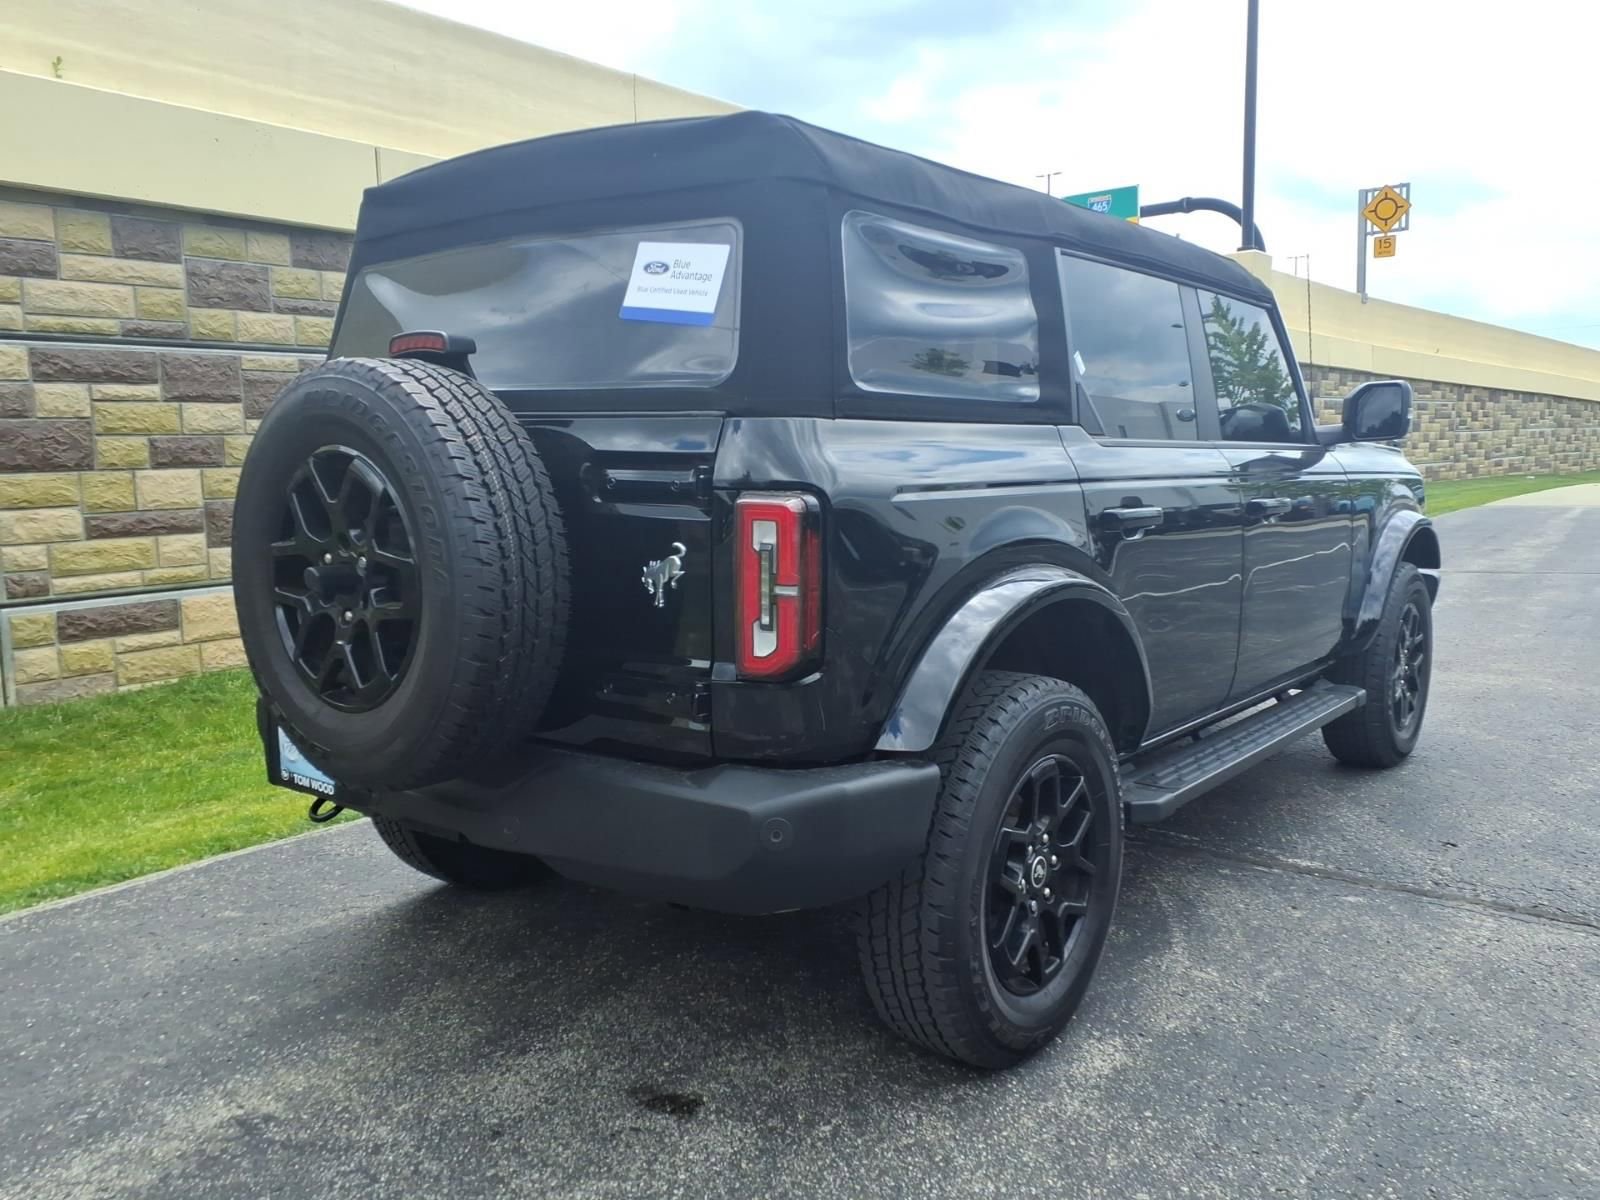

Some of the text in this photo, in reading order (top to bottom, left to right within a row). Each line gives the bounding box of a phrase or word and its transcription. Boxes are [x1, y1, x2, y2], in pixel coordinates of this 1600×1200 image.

[1091, 201, 1108, 212] 465
[1379, 238, 1392, 249] 15
[673, 259, 691, 269] Blue
[670, 271, 713, 283] Advantage
[293, 774, 335, 795] TOM WOOD
